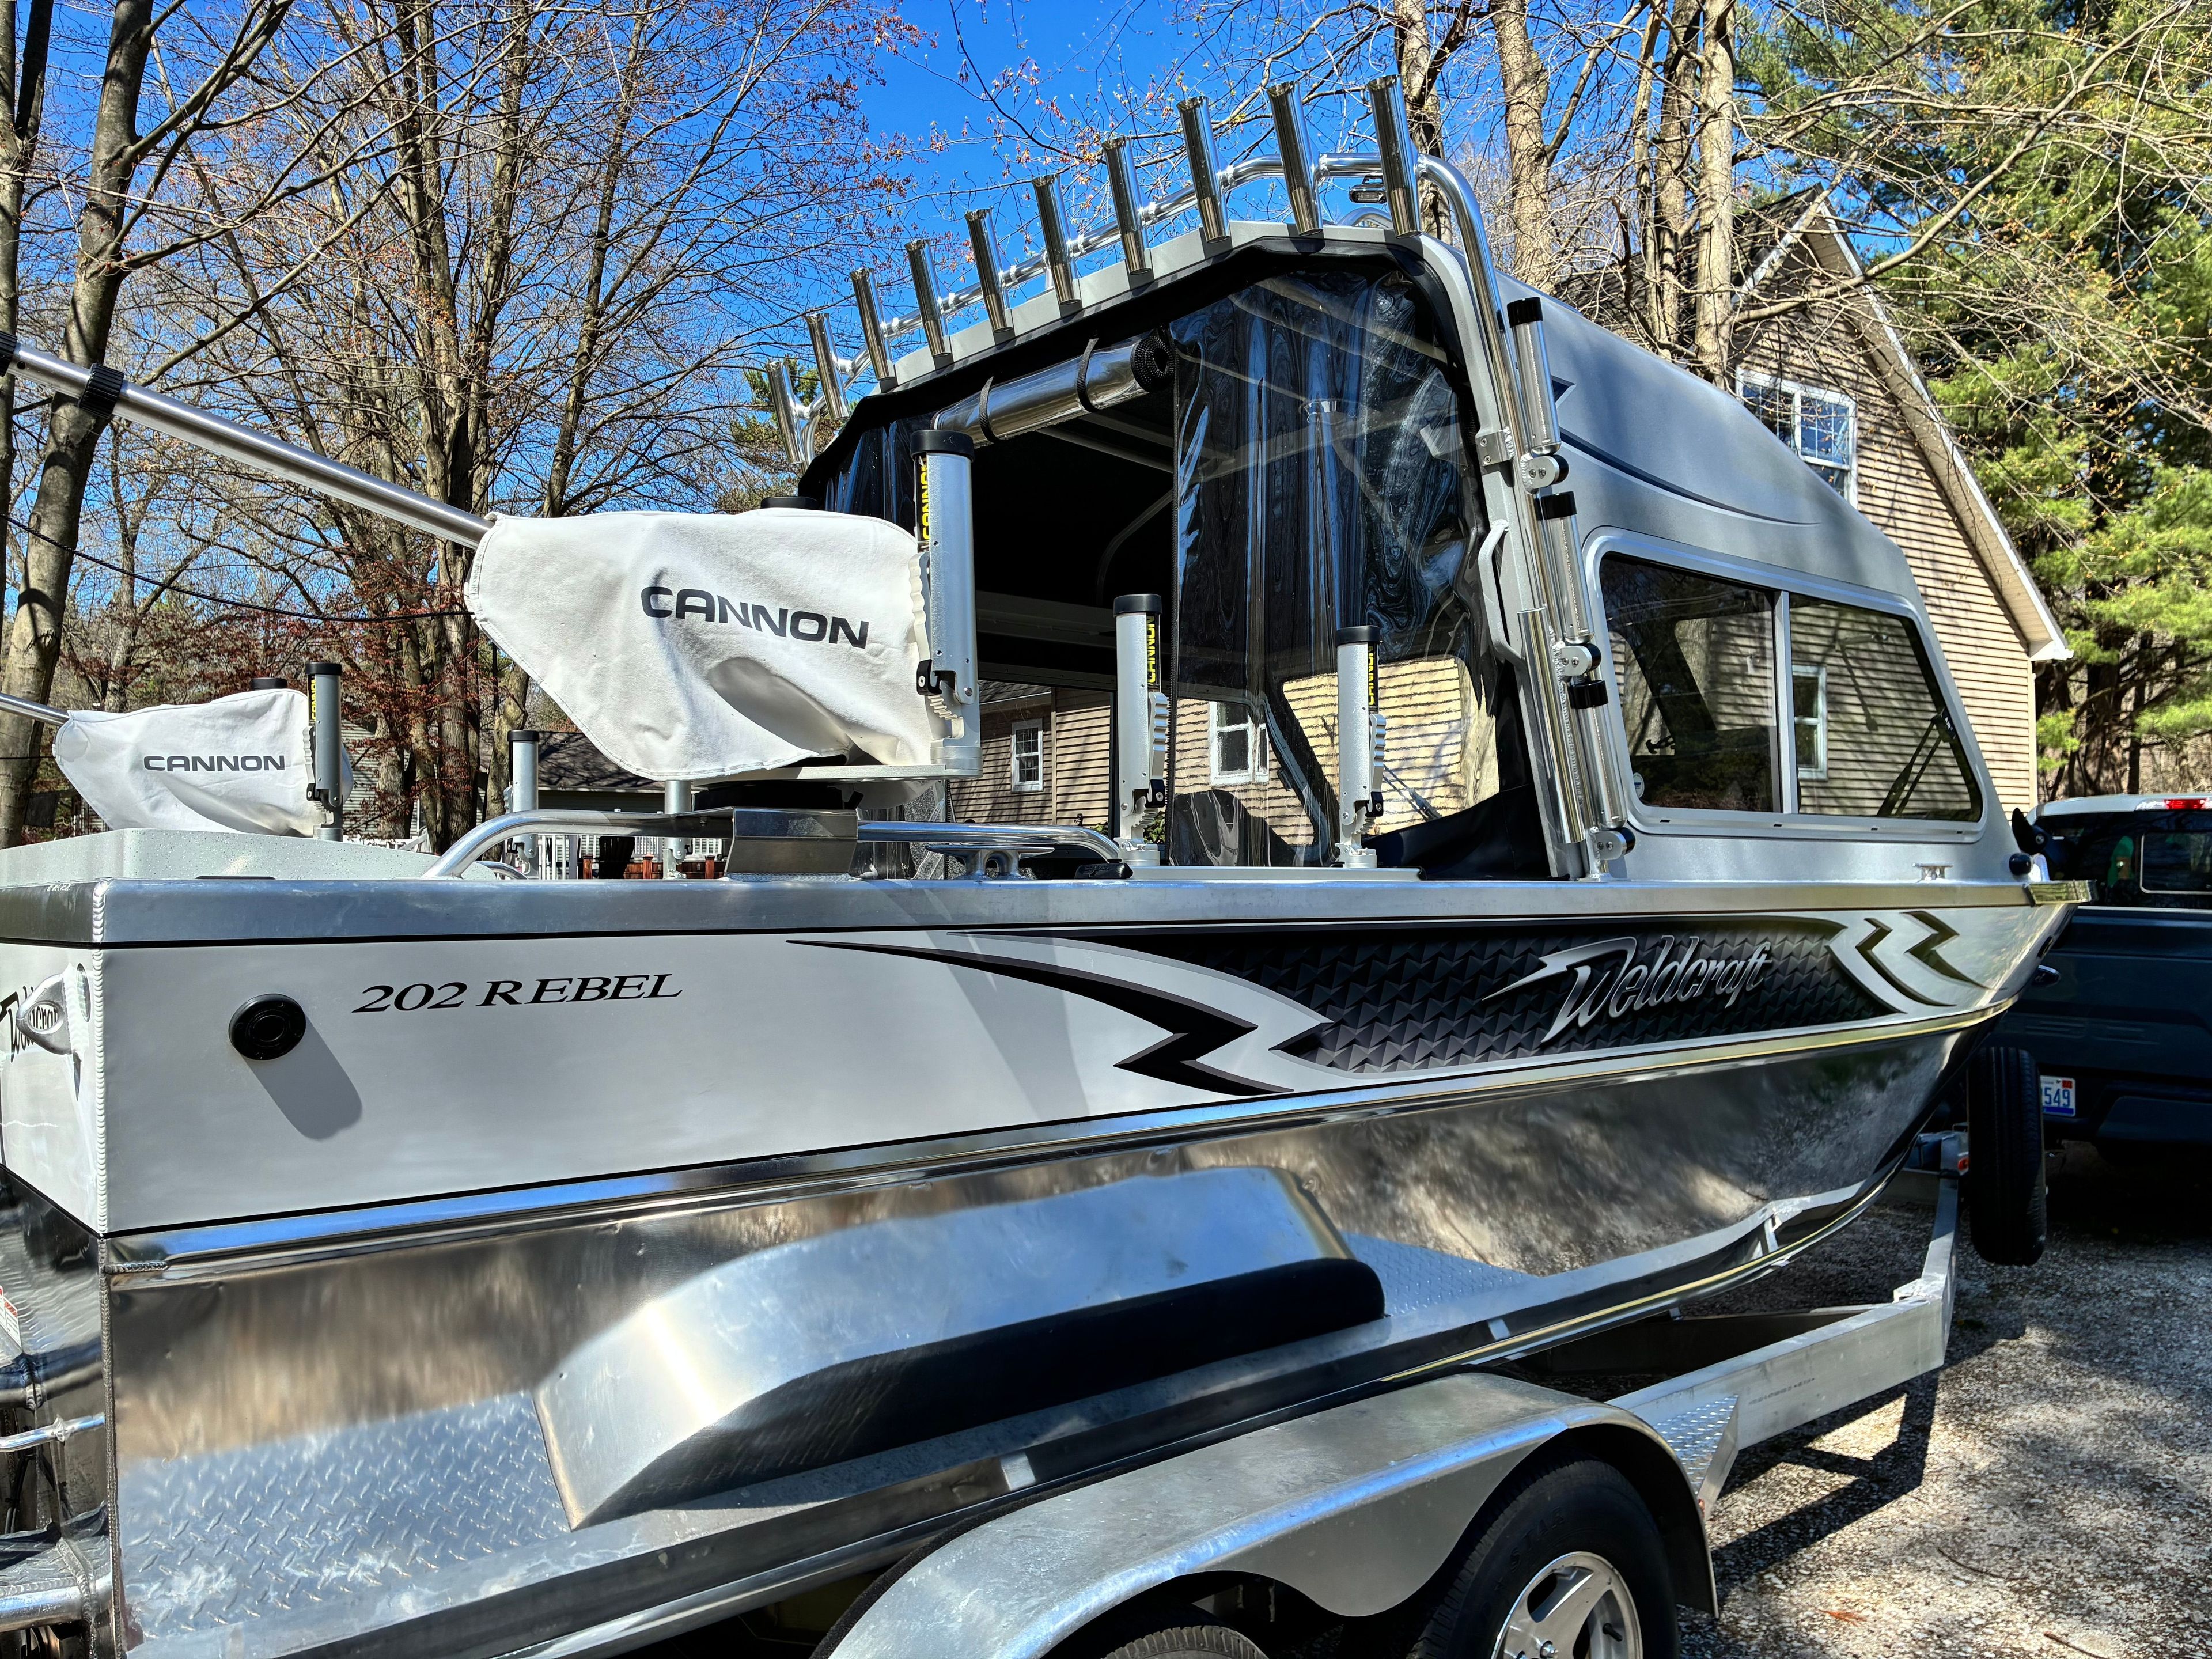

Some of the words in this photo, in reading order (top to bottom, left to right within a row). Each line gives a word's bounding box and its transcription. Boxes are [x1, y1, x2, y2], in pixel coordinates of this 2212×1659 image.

[641, 586, 869, 649] CANNON
[143, 755, 285, 771] CANNON
[351, 982, 468, 1013] 202
[475, 974, 683, 1007] REBEL
[1482, 934, 1772, 1043] Weldcraft
